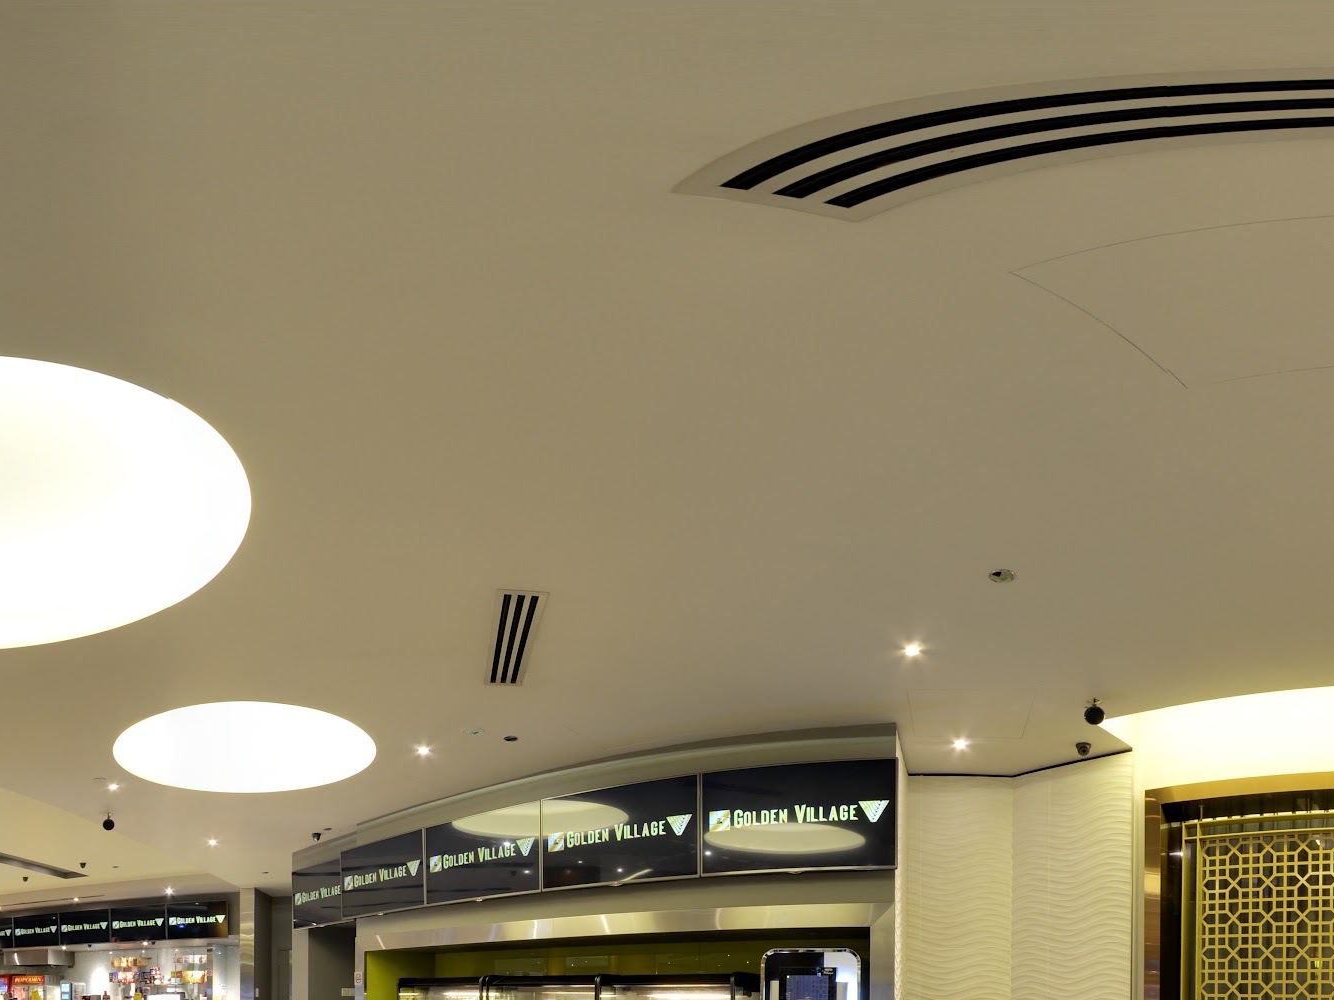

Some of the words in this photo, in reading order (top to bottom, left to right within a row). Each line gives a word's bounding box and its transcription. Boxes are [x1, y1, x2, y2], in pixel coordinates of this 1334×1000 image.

[734, 808, 787, 828] GOLDEN
[795, 804, 858, 823] VILLAGE
[567, 828, 609, 848] GOLDEN
[614, 820, 666, 841] VILLAGE
[443, 851, 474, 870] GOLDEN
[478, 842, 516, 862] VILLAGE
[354, 871, 376, 888] GOLDEN
[379, 865, 407, 882] VILLAGE
